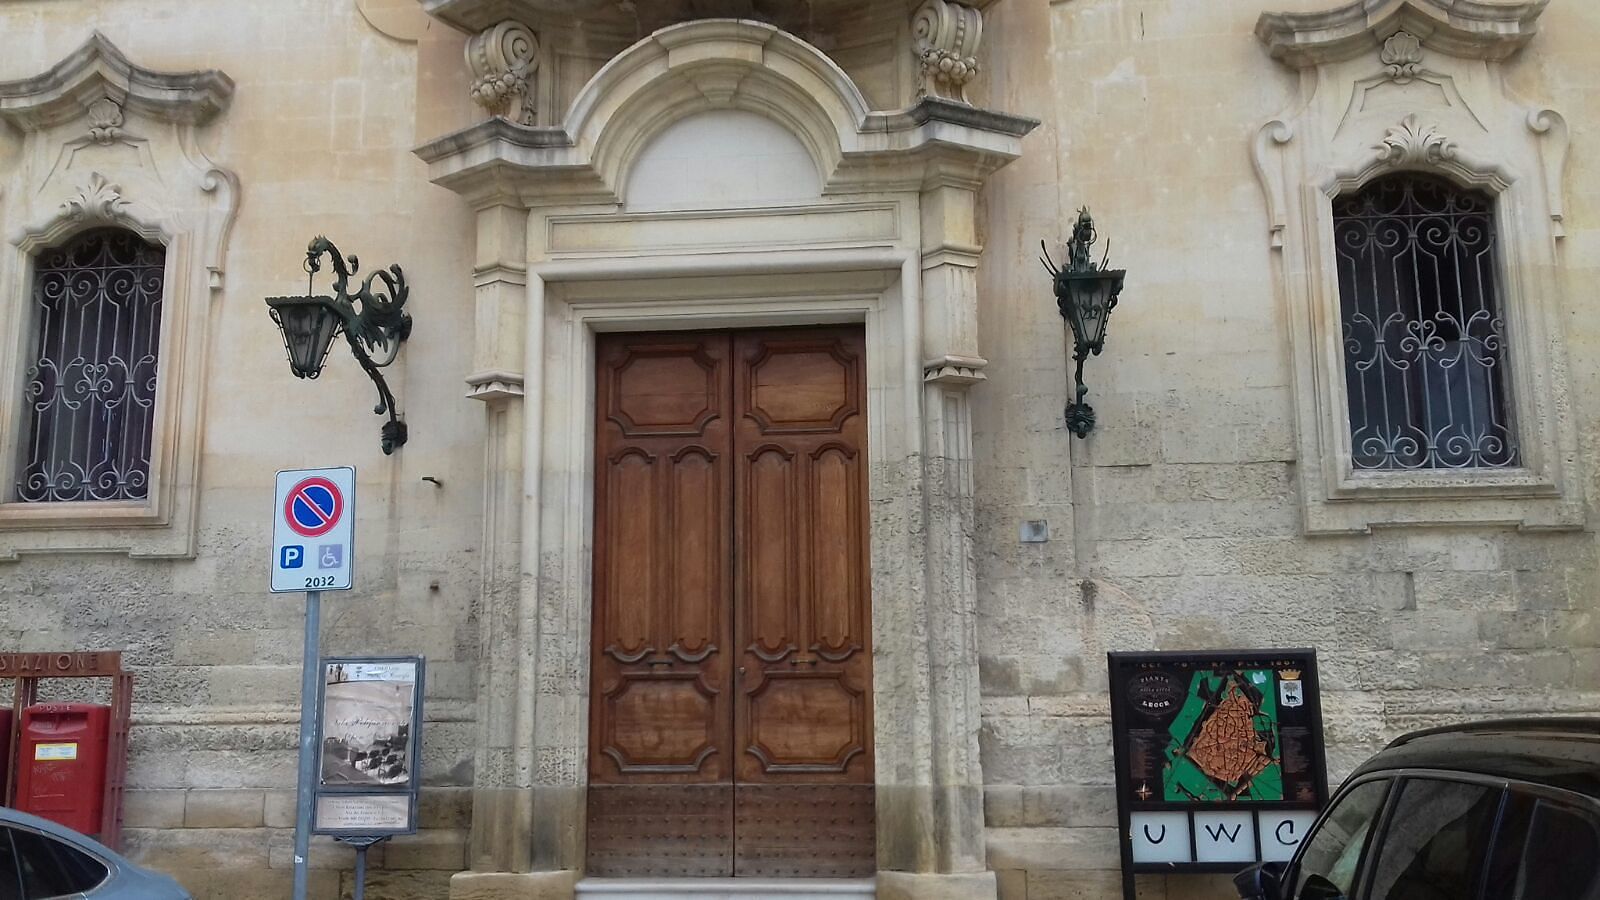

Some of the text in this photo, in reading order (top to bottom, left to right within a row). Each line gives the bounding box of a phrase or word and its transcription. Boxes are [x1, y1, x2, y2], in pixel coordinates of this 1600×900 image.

[285, 548, 299, 566] P
[305, 575, 335, 588] 2032
[1142, 700, 1170, 708] LECCE
